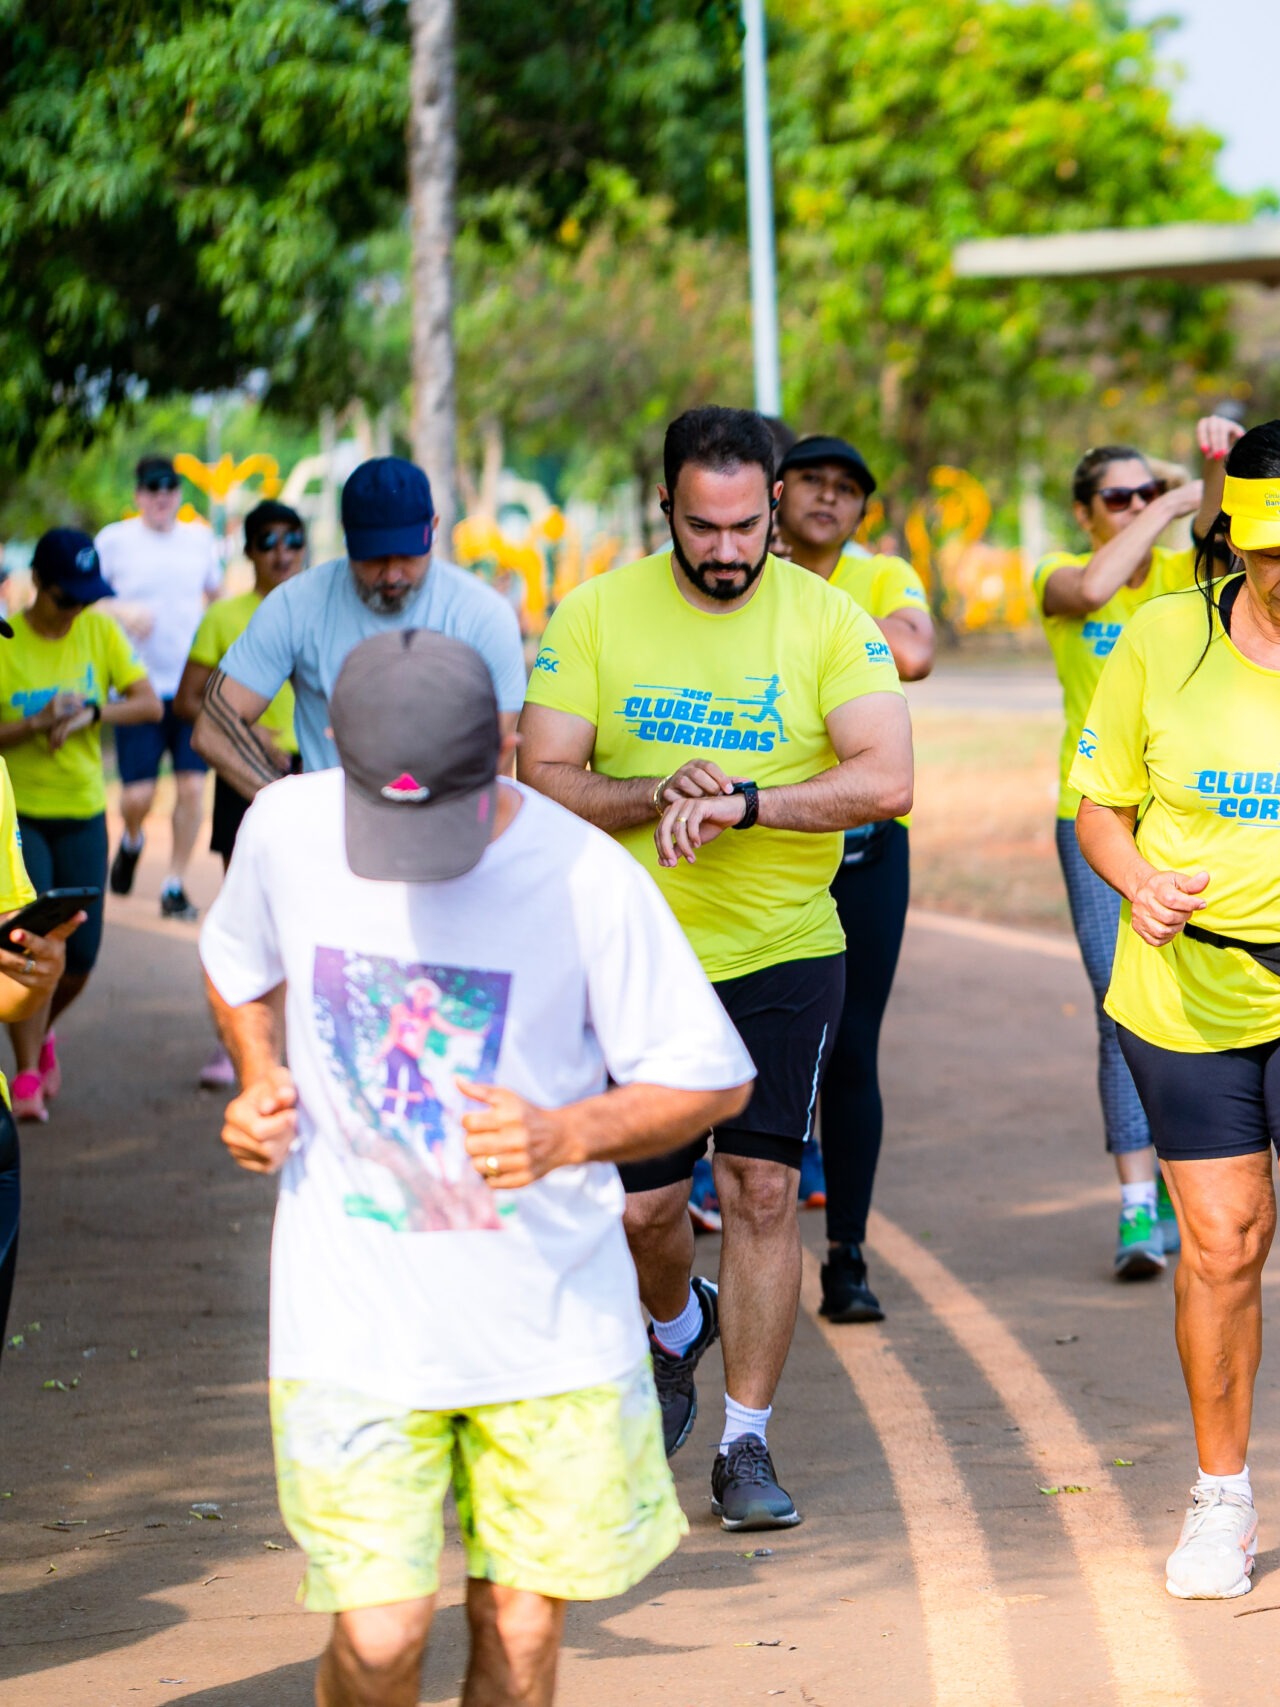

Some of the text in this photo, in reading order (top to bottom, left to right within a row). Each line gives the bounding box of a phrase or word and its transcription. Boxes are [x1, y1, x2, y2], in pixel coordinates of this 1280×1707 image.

[1083, 621, 1122, 638] CLU
[623, 696, 734, 727] CLUBE DE
[637, 720, 776, 752] CORRIDAS
